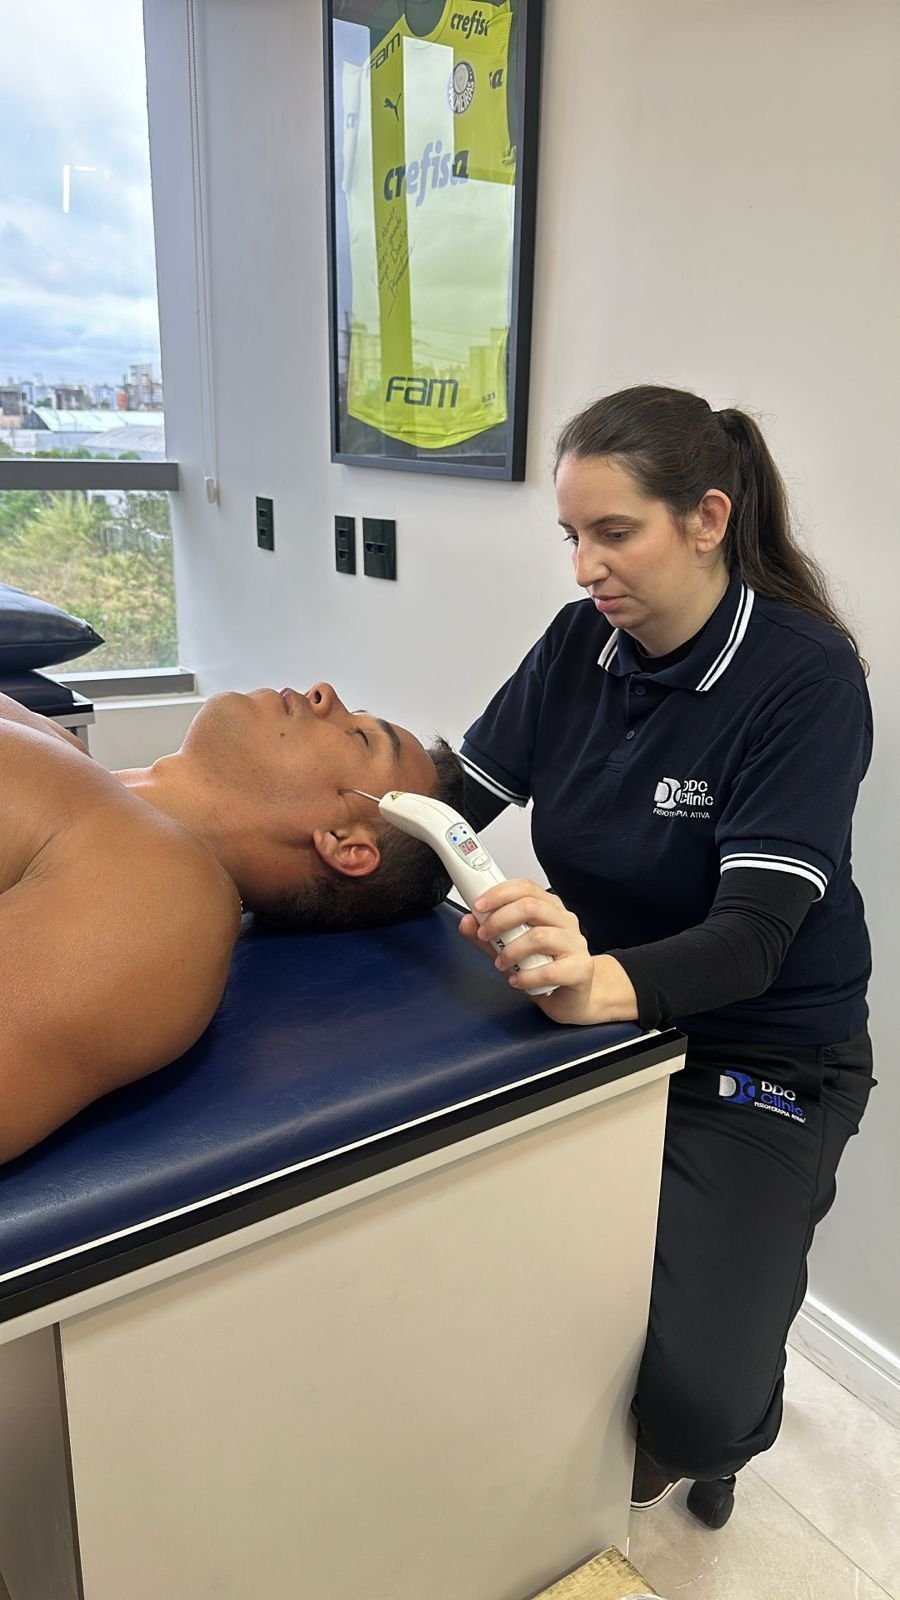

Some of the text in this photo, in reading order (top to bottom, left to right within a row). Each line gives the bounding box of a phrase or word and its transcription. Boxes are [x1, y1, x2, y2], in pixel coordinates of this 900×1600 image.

[384, 140, 469, 206] crefisa
[690, 811, 711, 819] ATIVA
[761, 1080, 796, 1101] DDC
